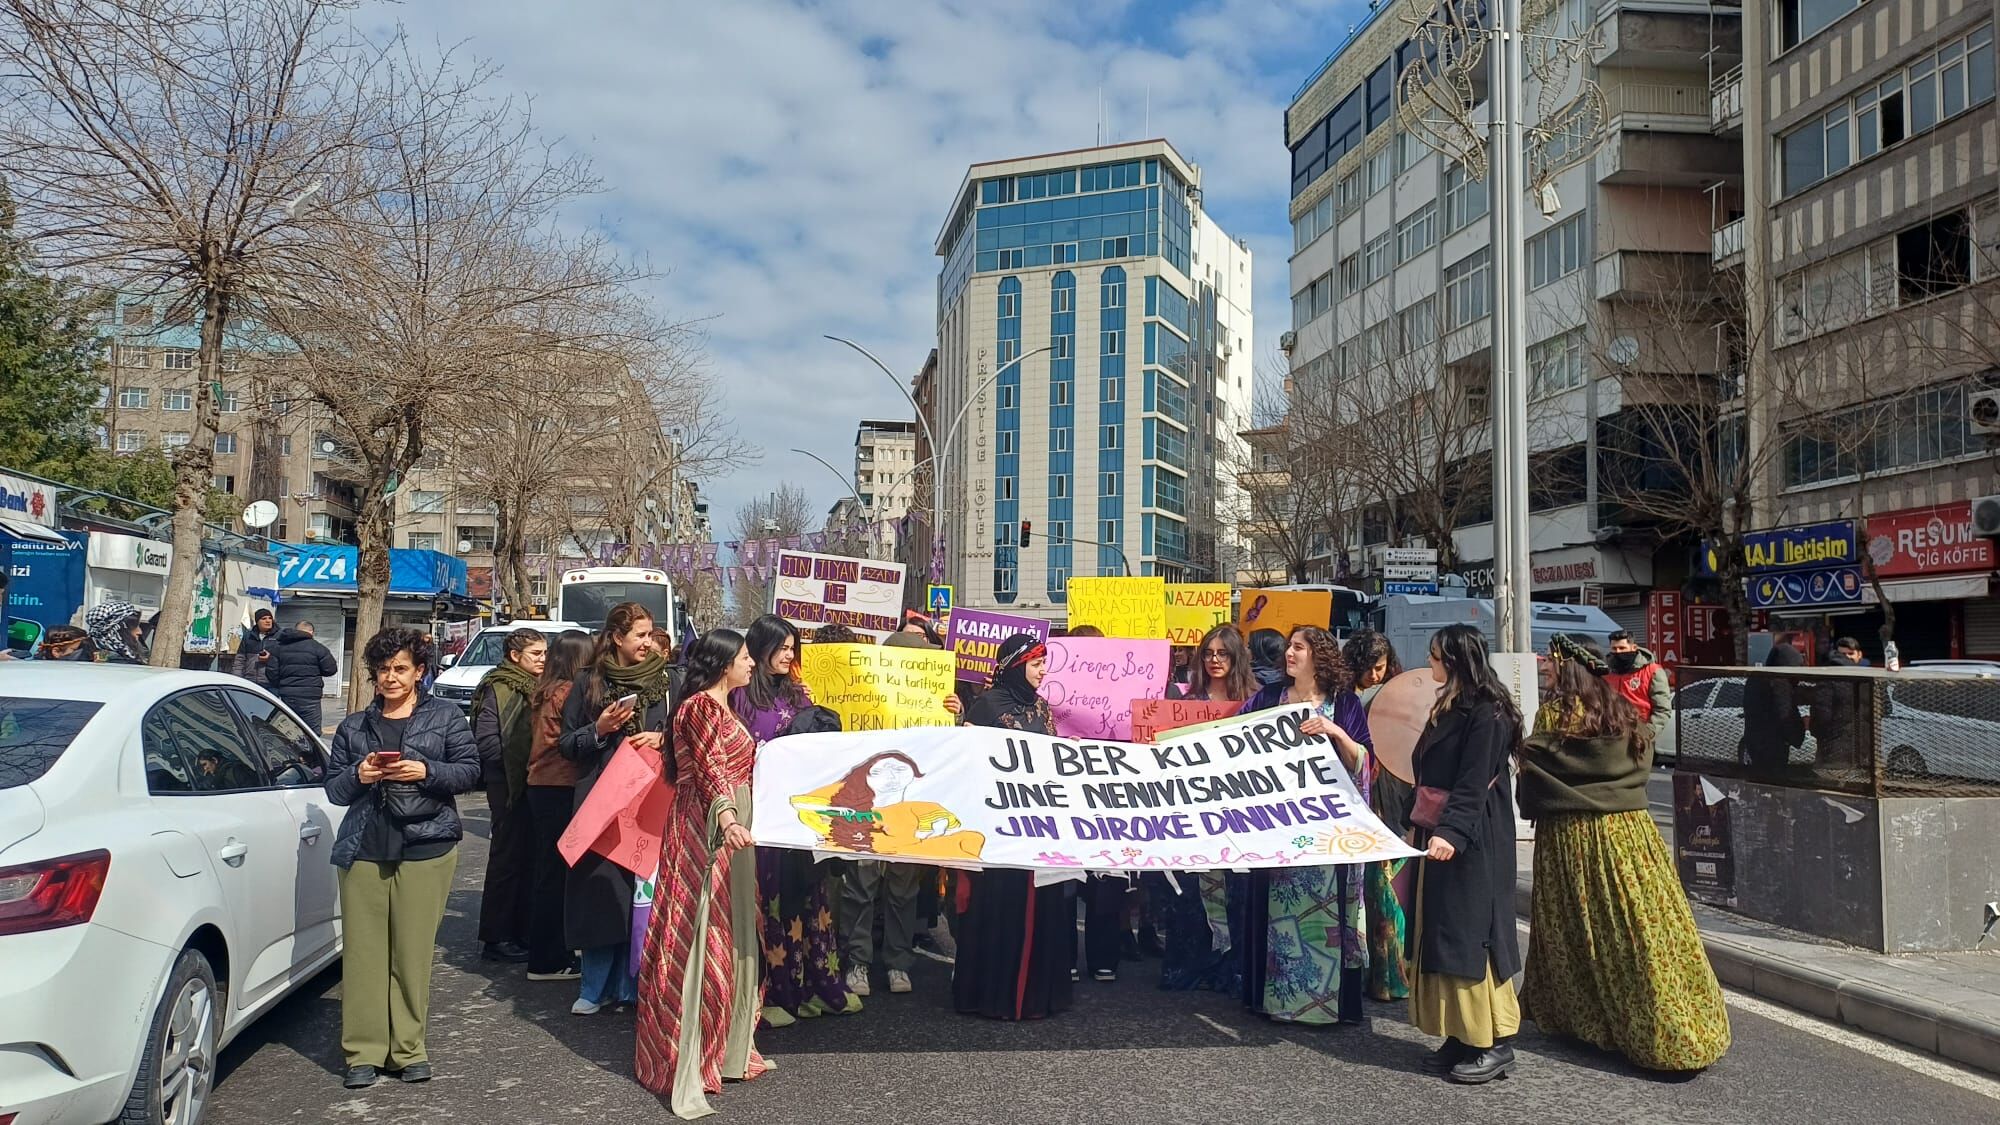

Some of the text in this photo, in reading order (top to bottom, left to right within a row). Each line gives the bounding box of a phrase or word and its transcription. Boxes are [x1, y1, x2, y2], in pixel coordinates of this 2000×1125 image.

[975, 348, 987, 548] PRESTIGE HOTEL
[144, 548, 167, 569] Garanti
[281, 555, 347, 580] 7/24
[783, 557, 809, 577] JIN
[1917, 546, 1988, 570] ÇİĞ KÖFTE
[849, 650, 872, 667] Em
[989, 737, 1034, 773] JI
[1052, 742, 1141, 776] BER
[1150, 742, 1211, 769] KU
[985, 780, 1070, 809] JINÊ
[1284, 755, 1338, 789] YE
[995, 815, 1060, 840] JIN
